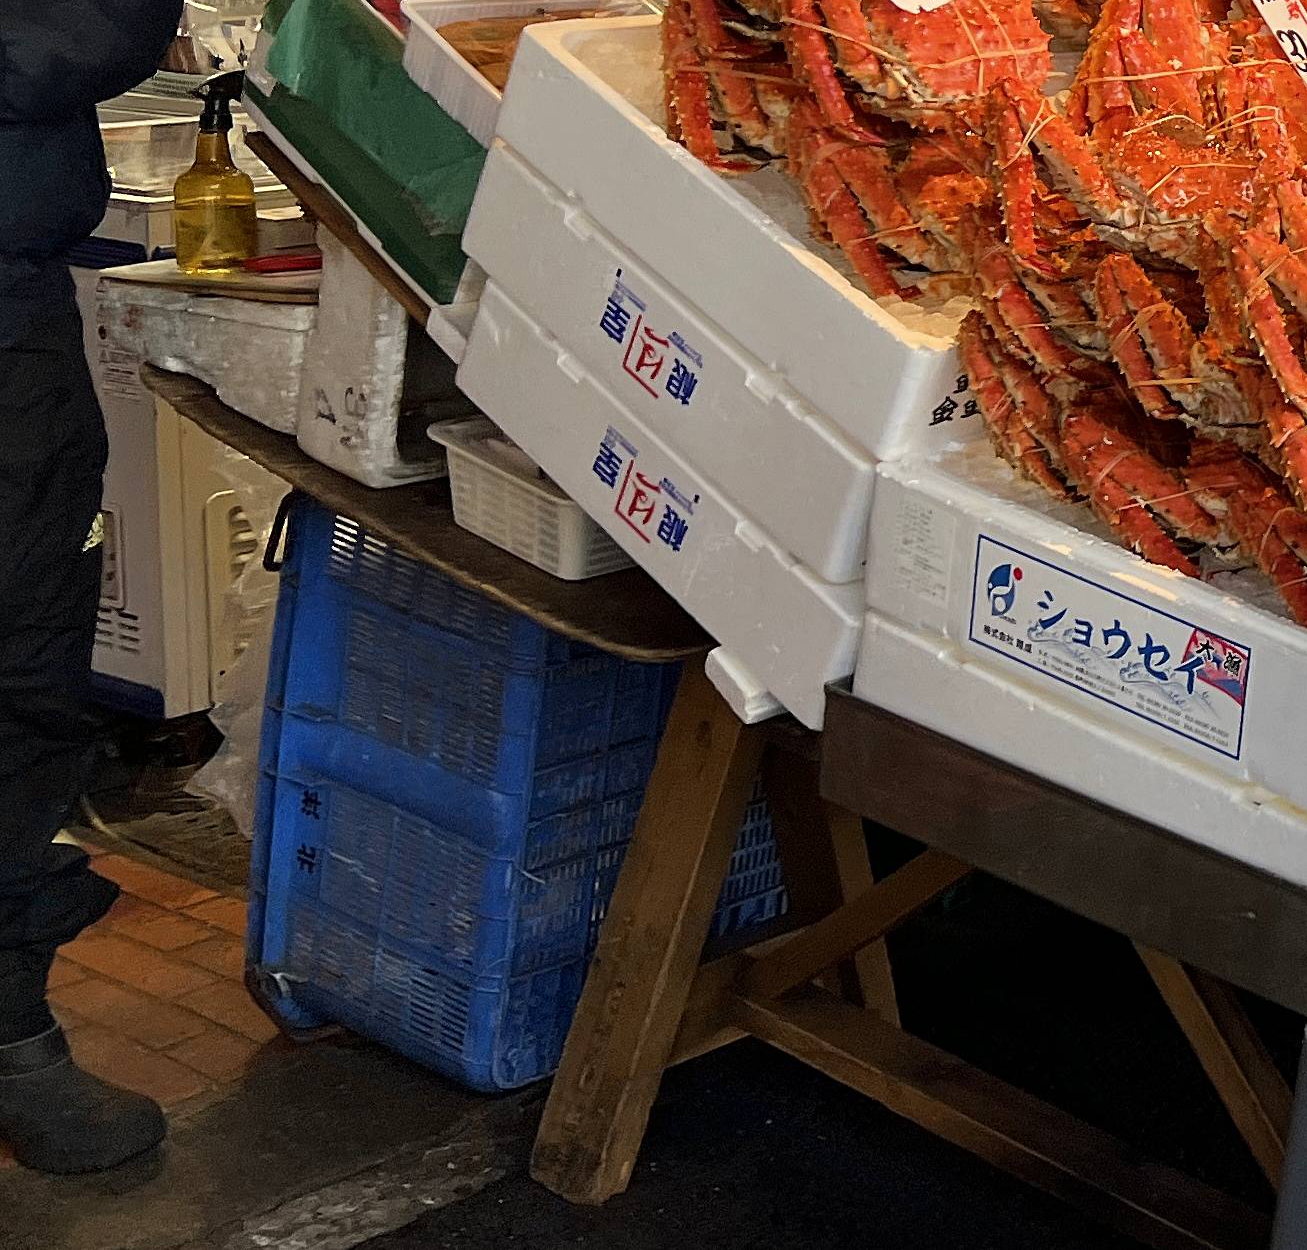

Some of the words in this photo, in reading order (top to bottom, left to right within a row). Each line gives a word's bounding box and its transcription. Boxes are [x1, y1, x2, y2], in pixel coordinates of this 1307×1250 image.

[1036, 589, 1205, 695] ショウセイ
